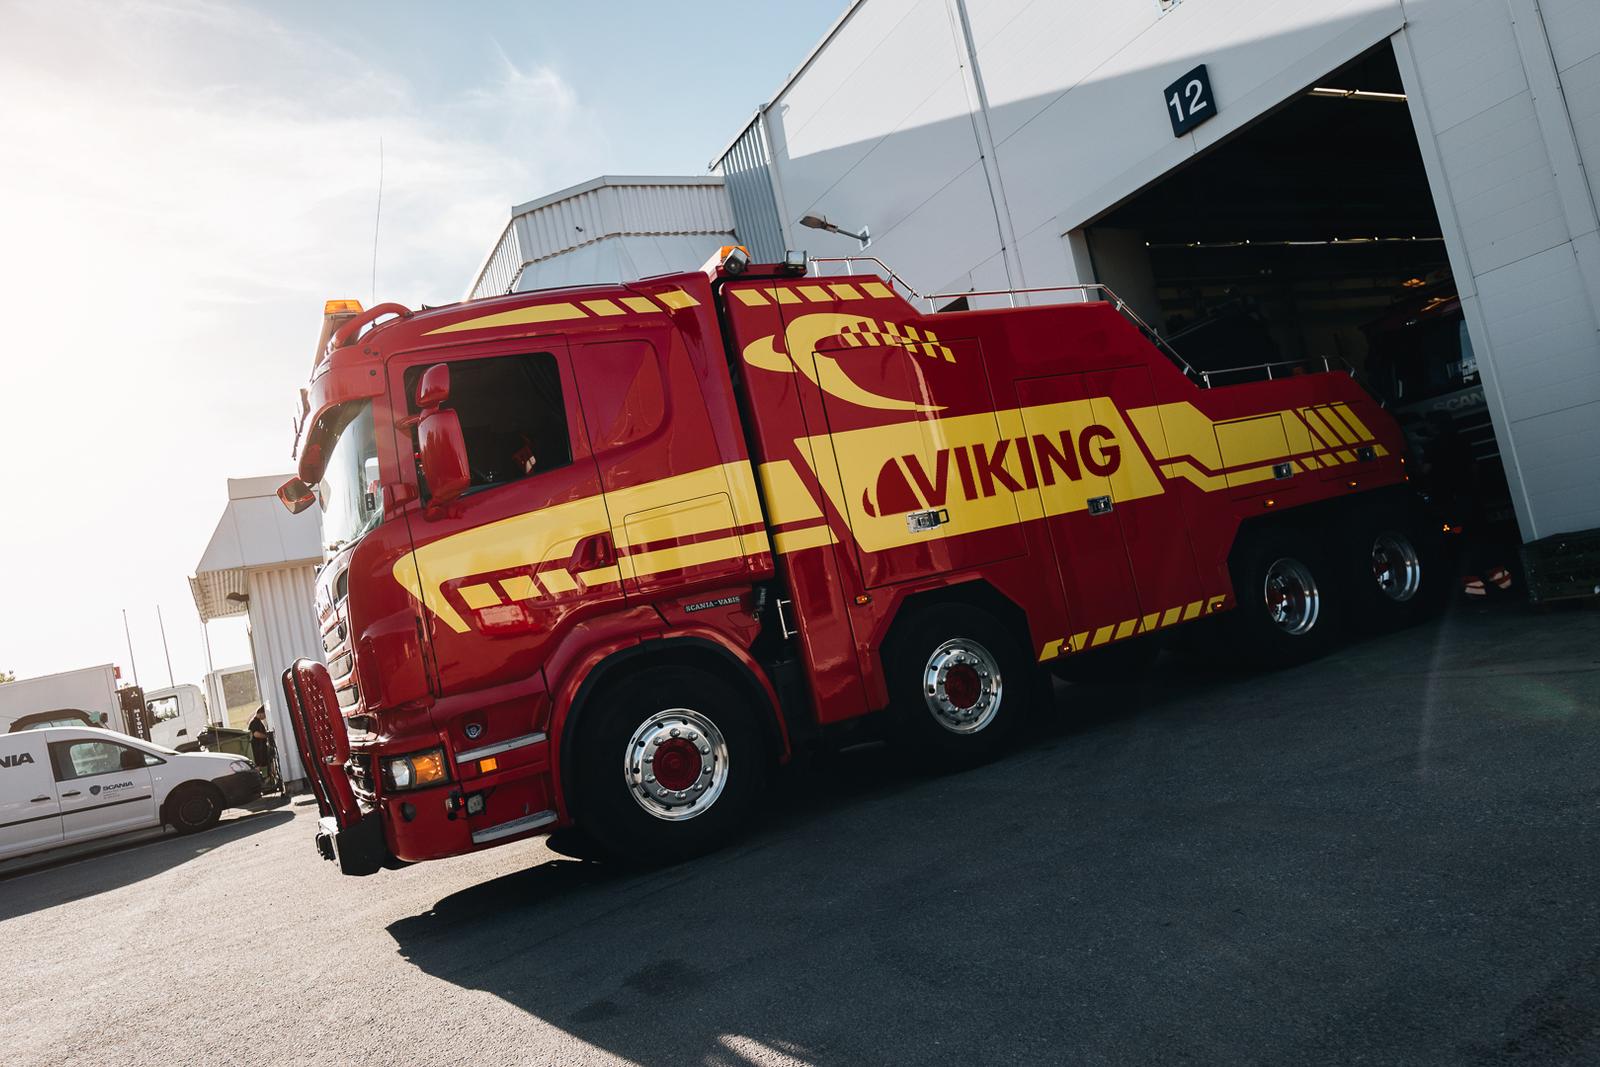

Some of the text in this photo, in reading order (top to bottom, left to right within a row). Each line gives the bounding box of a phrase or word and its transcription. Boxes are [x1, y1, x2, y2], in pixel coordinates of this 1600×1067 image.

[1169, 79, 1207, 122] 12
[901, 424, 1121, 507] VIKING
[103, 781, 133, 791] SCANIA
